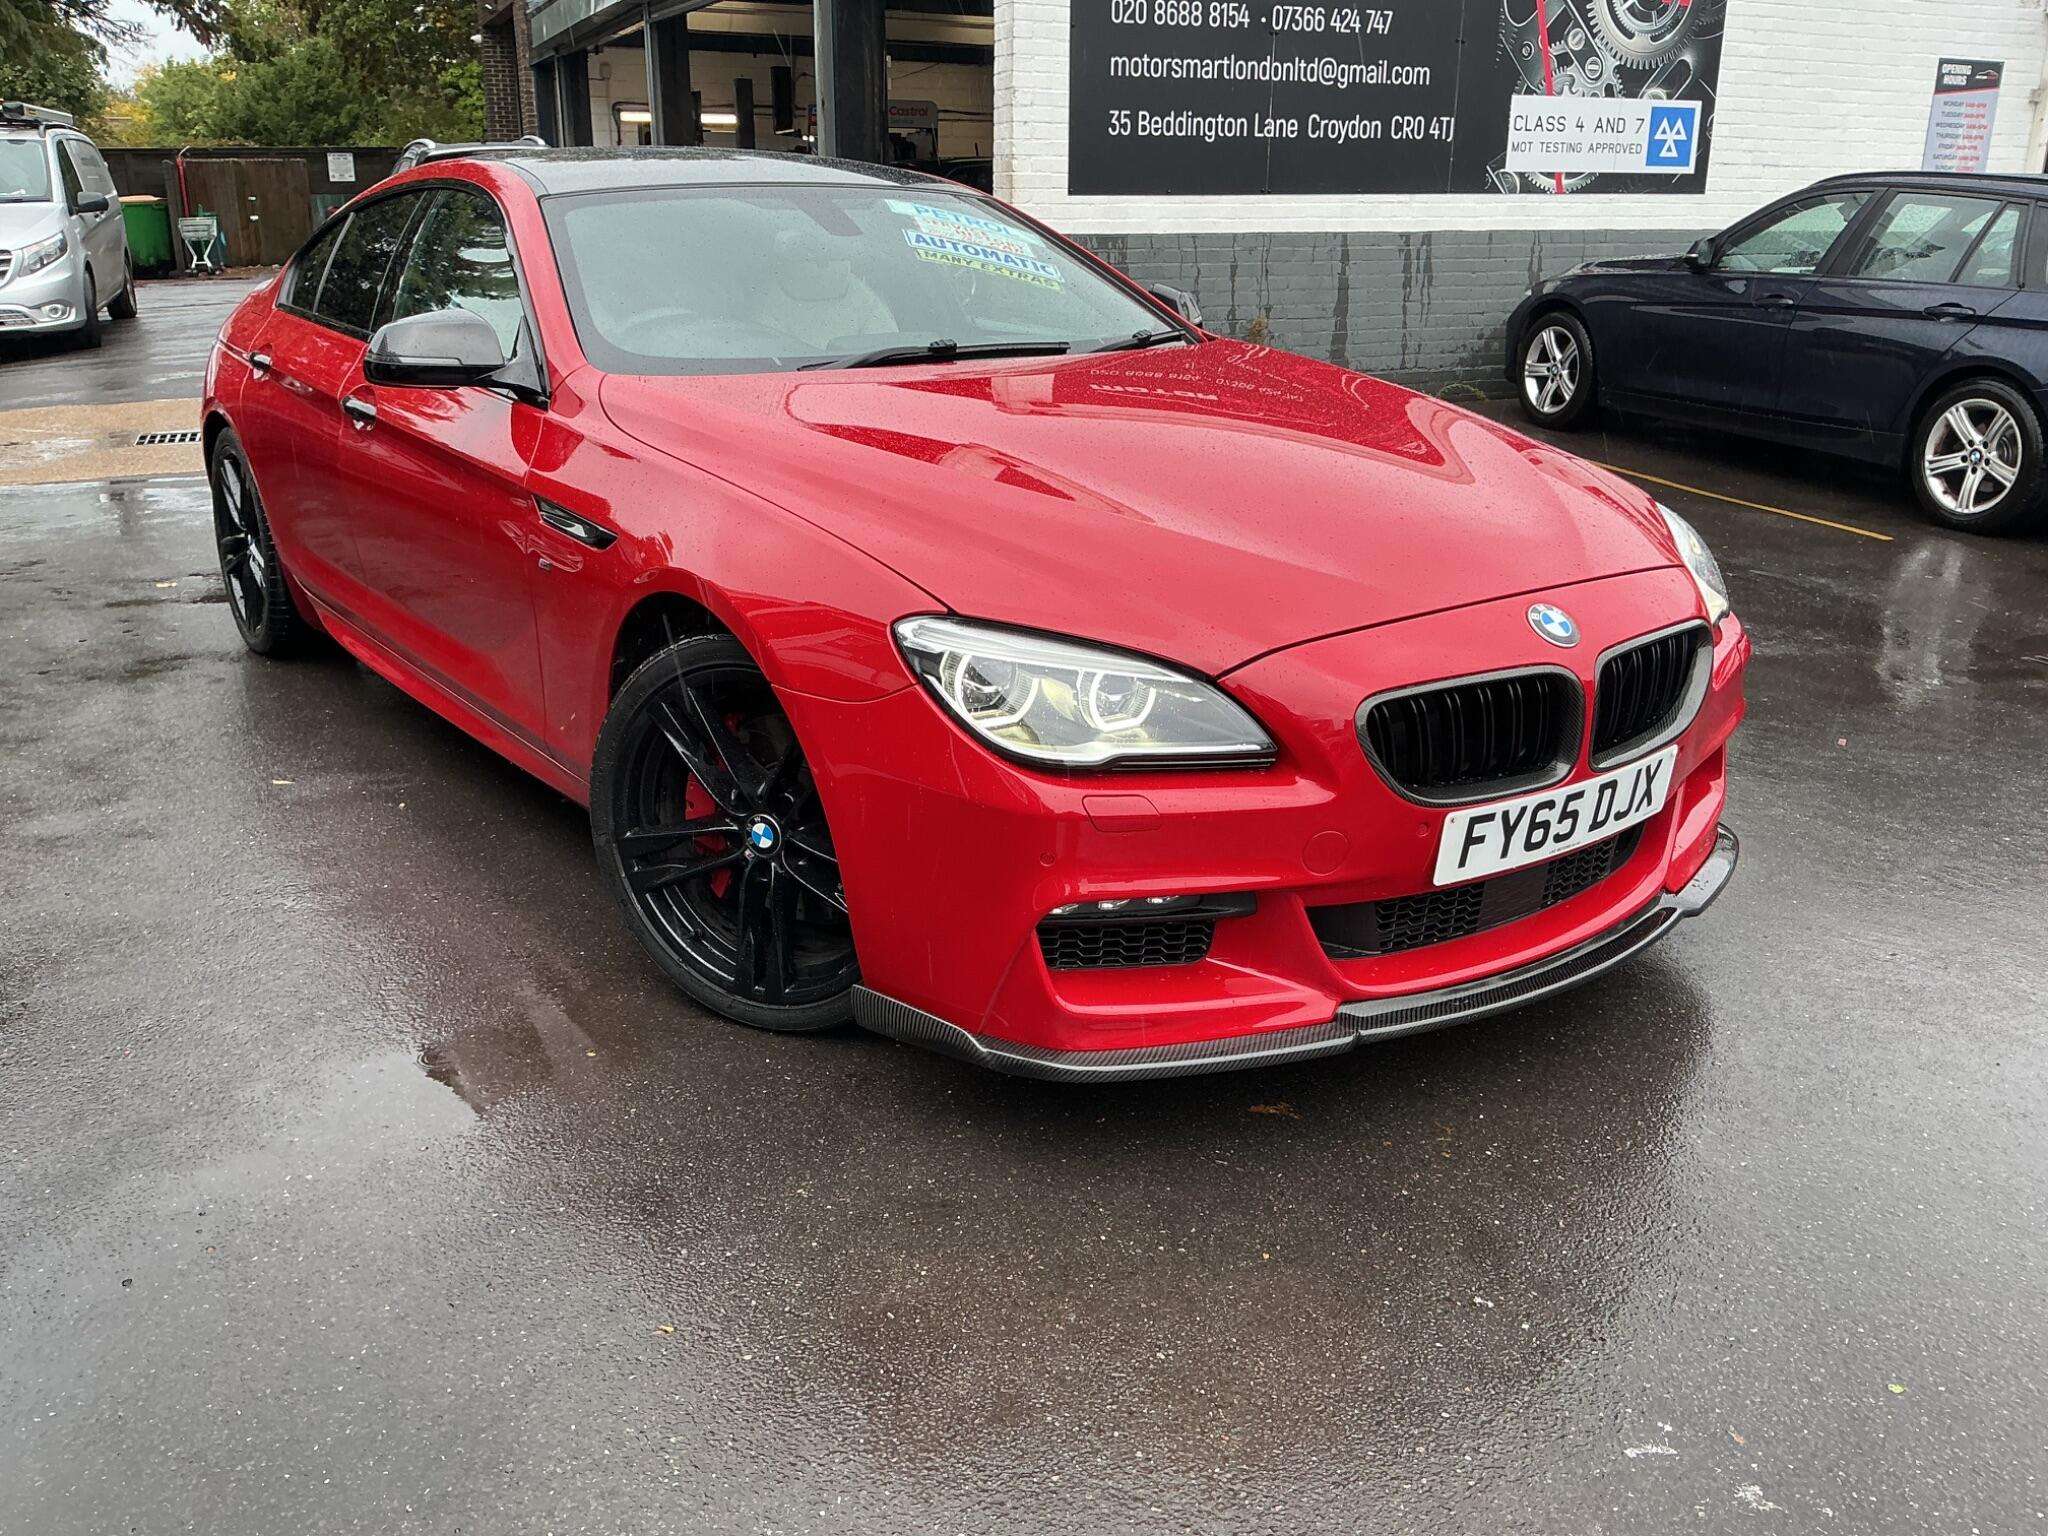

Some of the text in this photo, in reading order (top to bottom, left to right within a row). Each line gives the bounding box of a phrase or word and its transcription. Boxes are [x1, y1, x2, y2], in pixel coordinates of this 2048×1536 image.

[1111, 0, 1393, 34] 020 8688 8154 07366 424 747
[1110, 54, 1430, 88] motorsmartlondonltd@gmail.com
[1108, 110, 1131, 136] 35
[1138, 110, 1248, 142] Beddington
[1254, 113, 1299, 138] Lane
[1307, 114, 1382, 144] Croydon
[1429, 117, 1455, 142] 4TJ
[1513, 115, 1645, 134] CLASS 4 AND 7
[1511, 141, 1643, 155] MOT TESTING APPROVED
[914, 234, 1056, 277] AUTOMATIC
[924, 250, 973, 267] MANY
[1458, 758, 1664, 868] FY65 DJX
